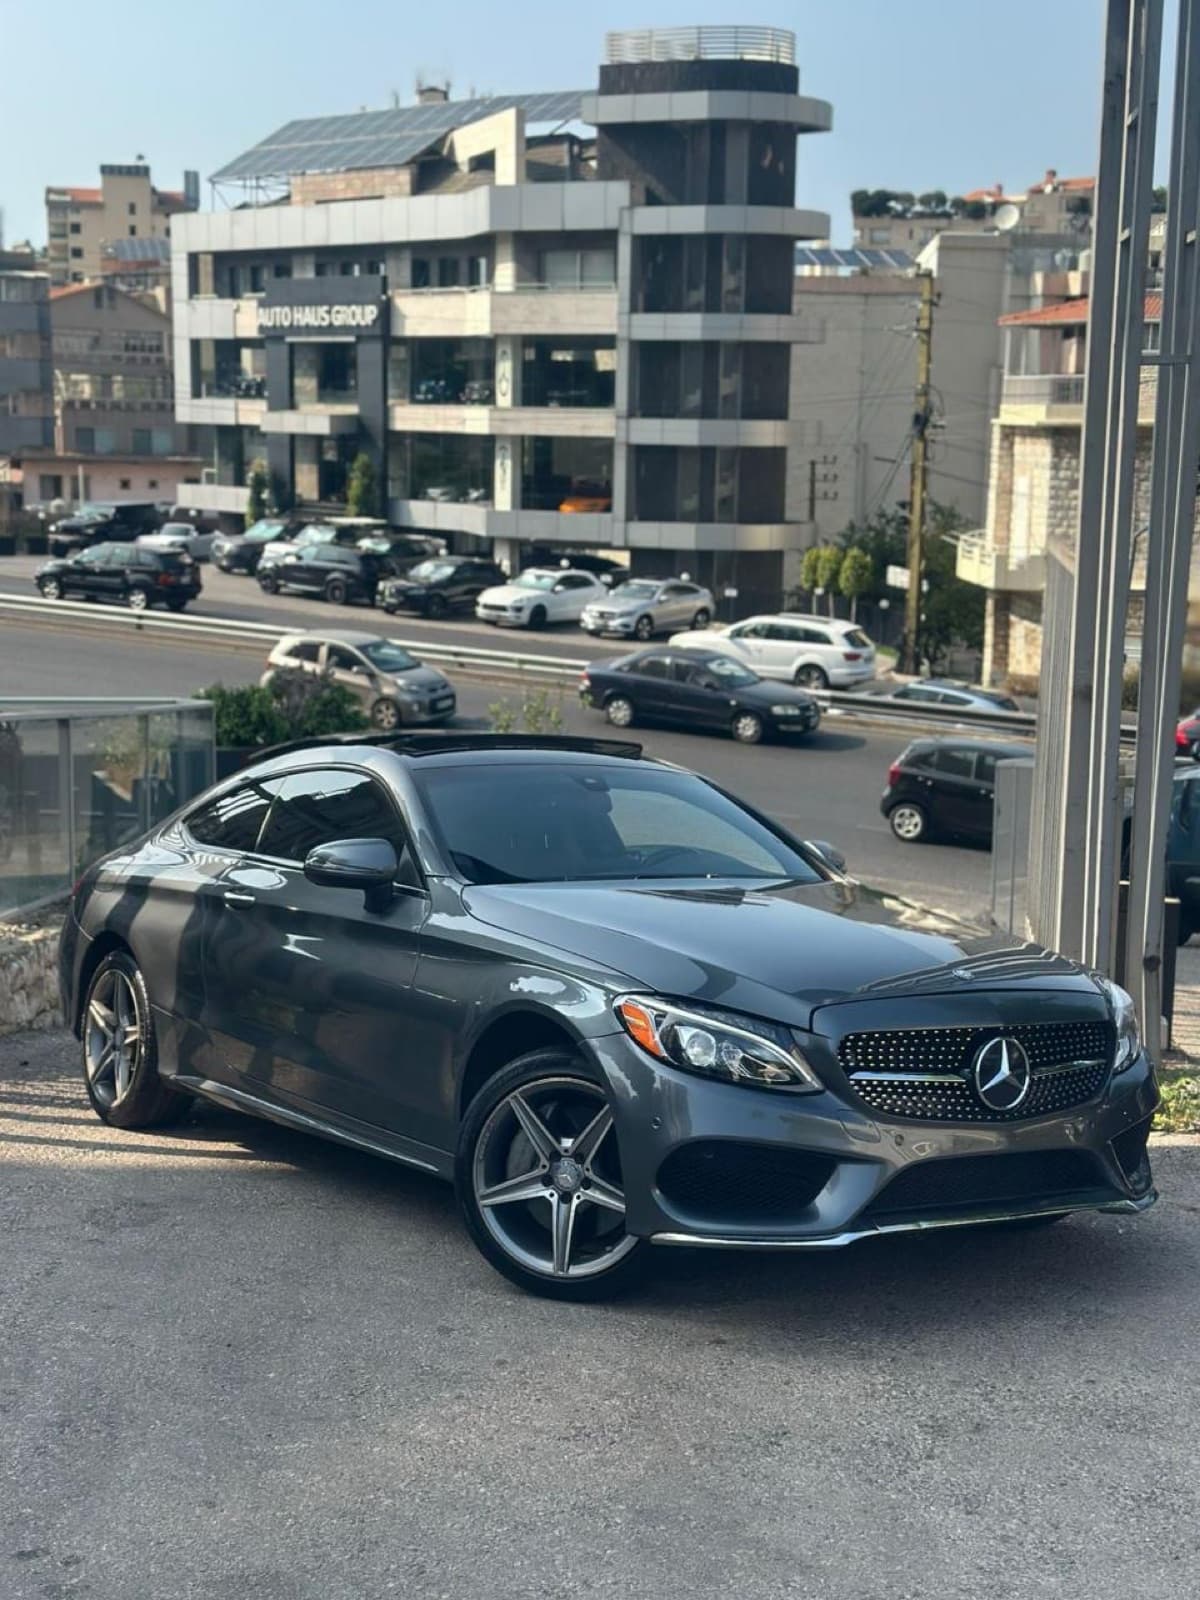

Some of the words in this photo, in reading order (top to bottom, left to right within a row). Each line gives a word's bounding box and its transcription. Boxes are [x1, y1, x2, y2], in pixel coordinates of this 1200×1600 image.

[258, 306, 292, 327] AUTO
[293, 305, 330, 326] HAUS
[331, 304, 378, 326] GROUP
